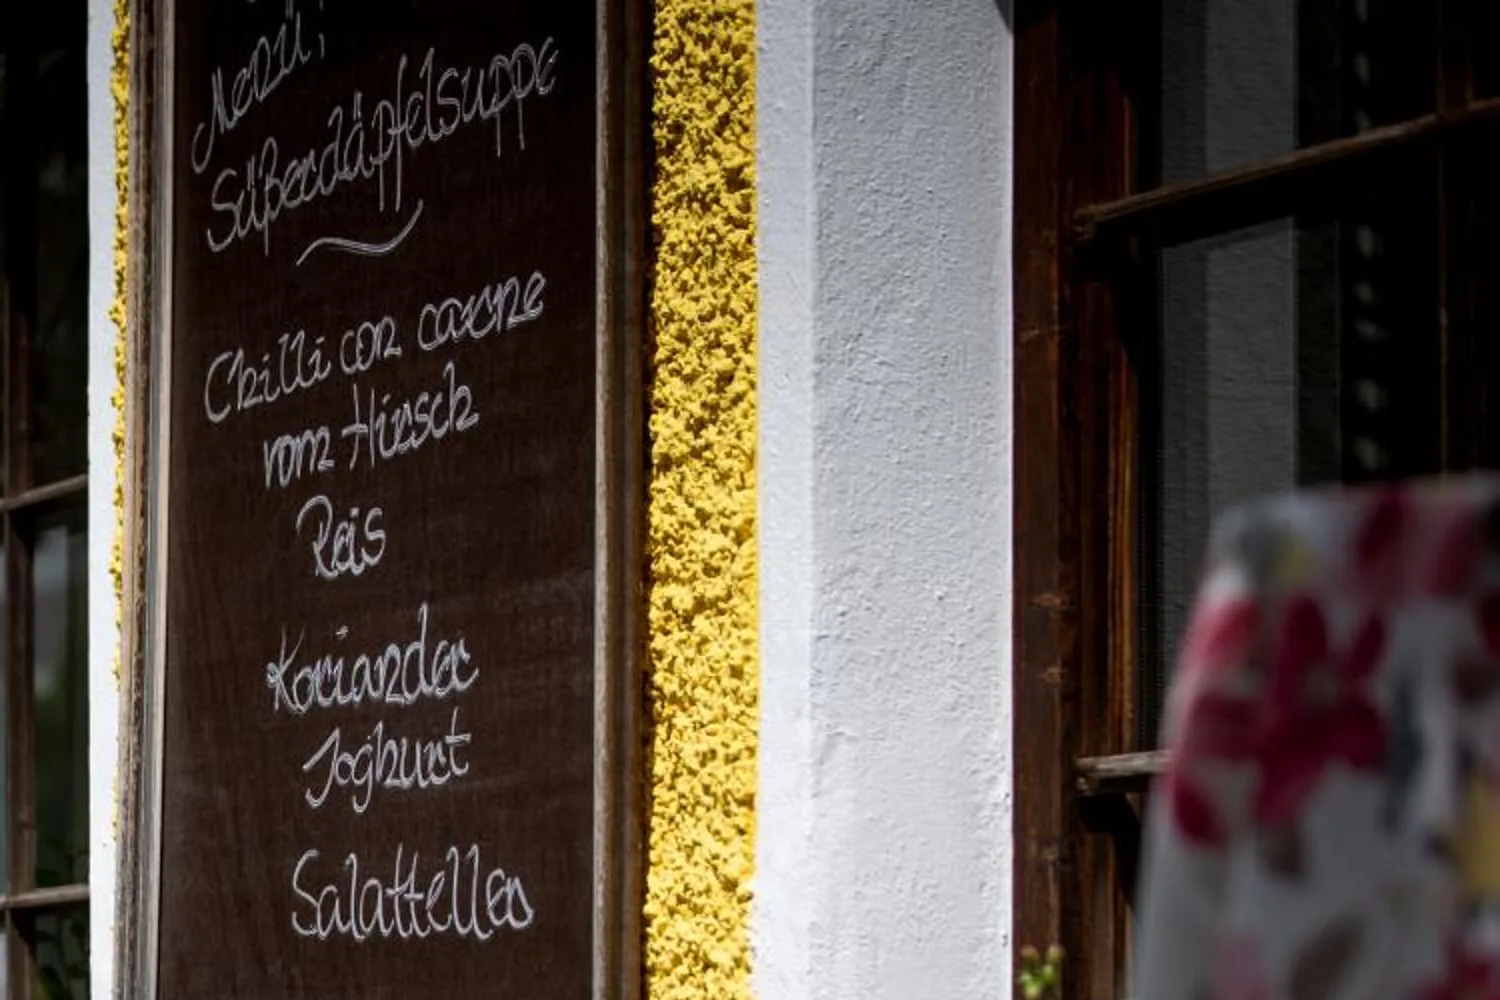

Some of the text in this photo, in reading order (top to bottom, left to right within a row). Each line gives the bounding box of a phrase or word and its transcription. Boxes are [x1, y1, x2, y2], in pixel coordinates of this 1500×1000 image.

[204, 270, 547, 424] Chilli con carne
[263, 361, 480, 488] vom Hirsch
[296, 495, 387, 580] Reis
[266, 602, 480, 714] Koriander
[303, 707, 471, 813] Joghurt
